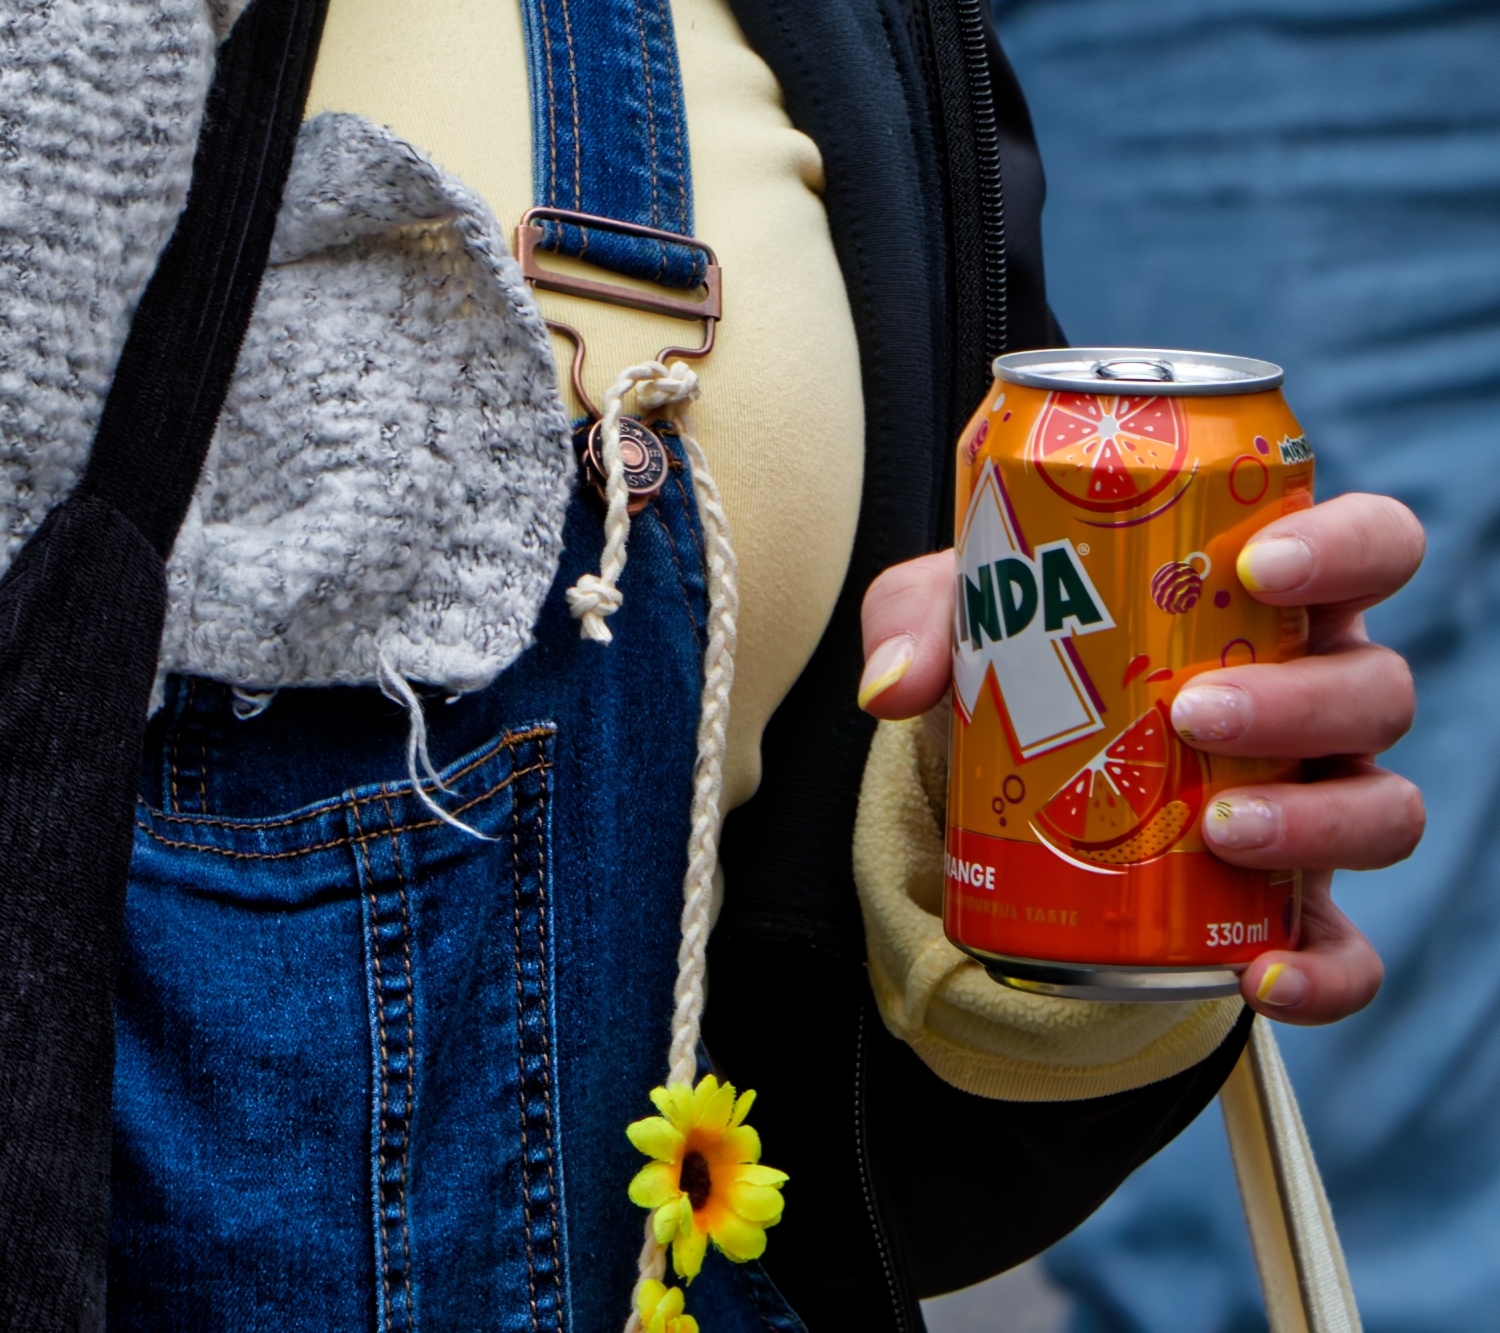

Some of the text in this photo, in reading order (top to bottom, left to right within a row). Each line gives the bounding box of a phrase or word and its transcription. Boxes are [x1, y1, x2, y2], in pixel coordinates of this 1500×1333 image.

[955, 546, 1104, 654] INDA
[944, 852, 997, 891] RANGE
[1024, 905, 1079, 927] TASTE
[1206, 917, 1269, 947] 330 ml
